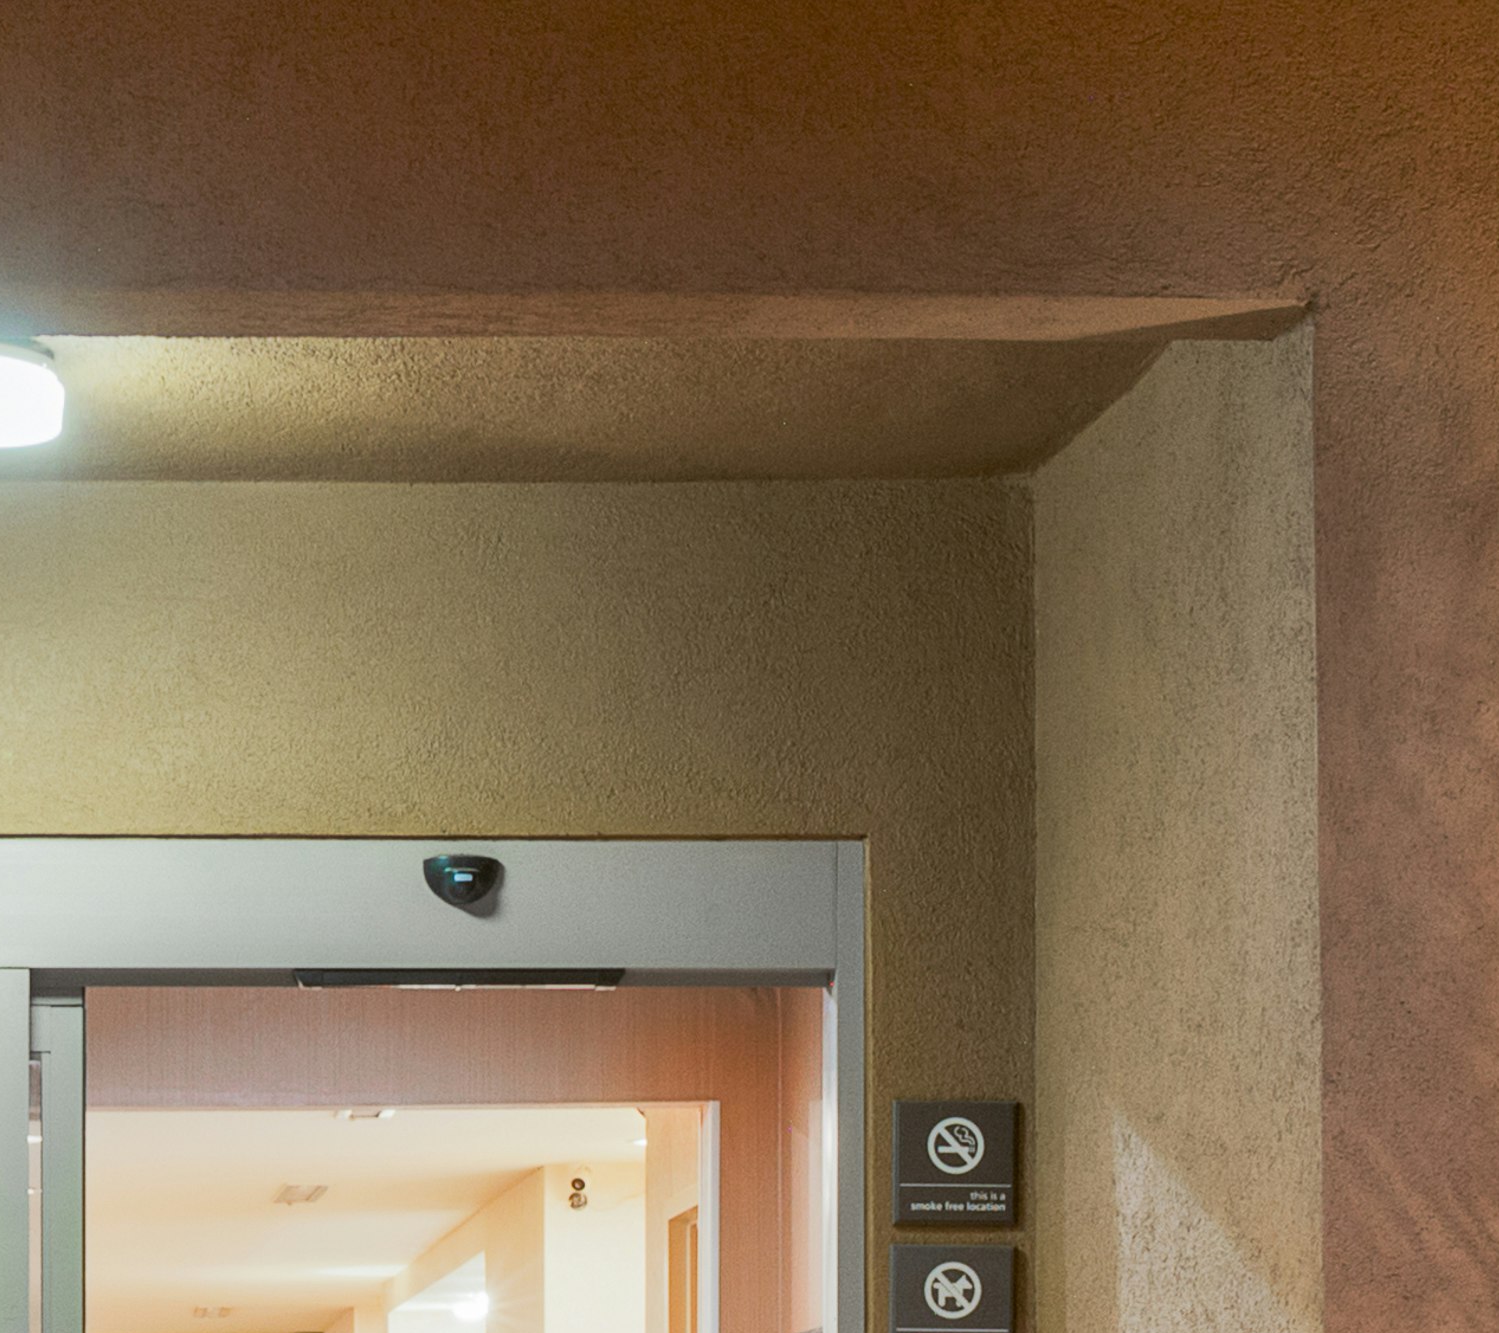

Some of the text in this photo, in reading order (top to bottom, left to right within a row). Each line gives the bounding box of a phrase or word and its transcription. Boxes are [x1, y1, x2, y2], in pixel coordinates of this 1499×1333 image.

[970, 1191, 1006, 1201] this is a
[910, 1201, 1006, 1212] smoke free location
